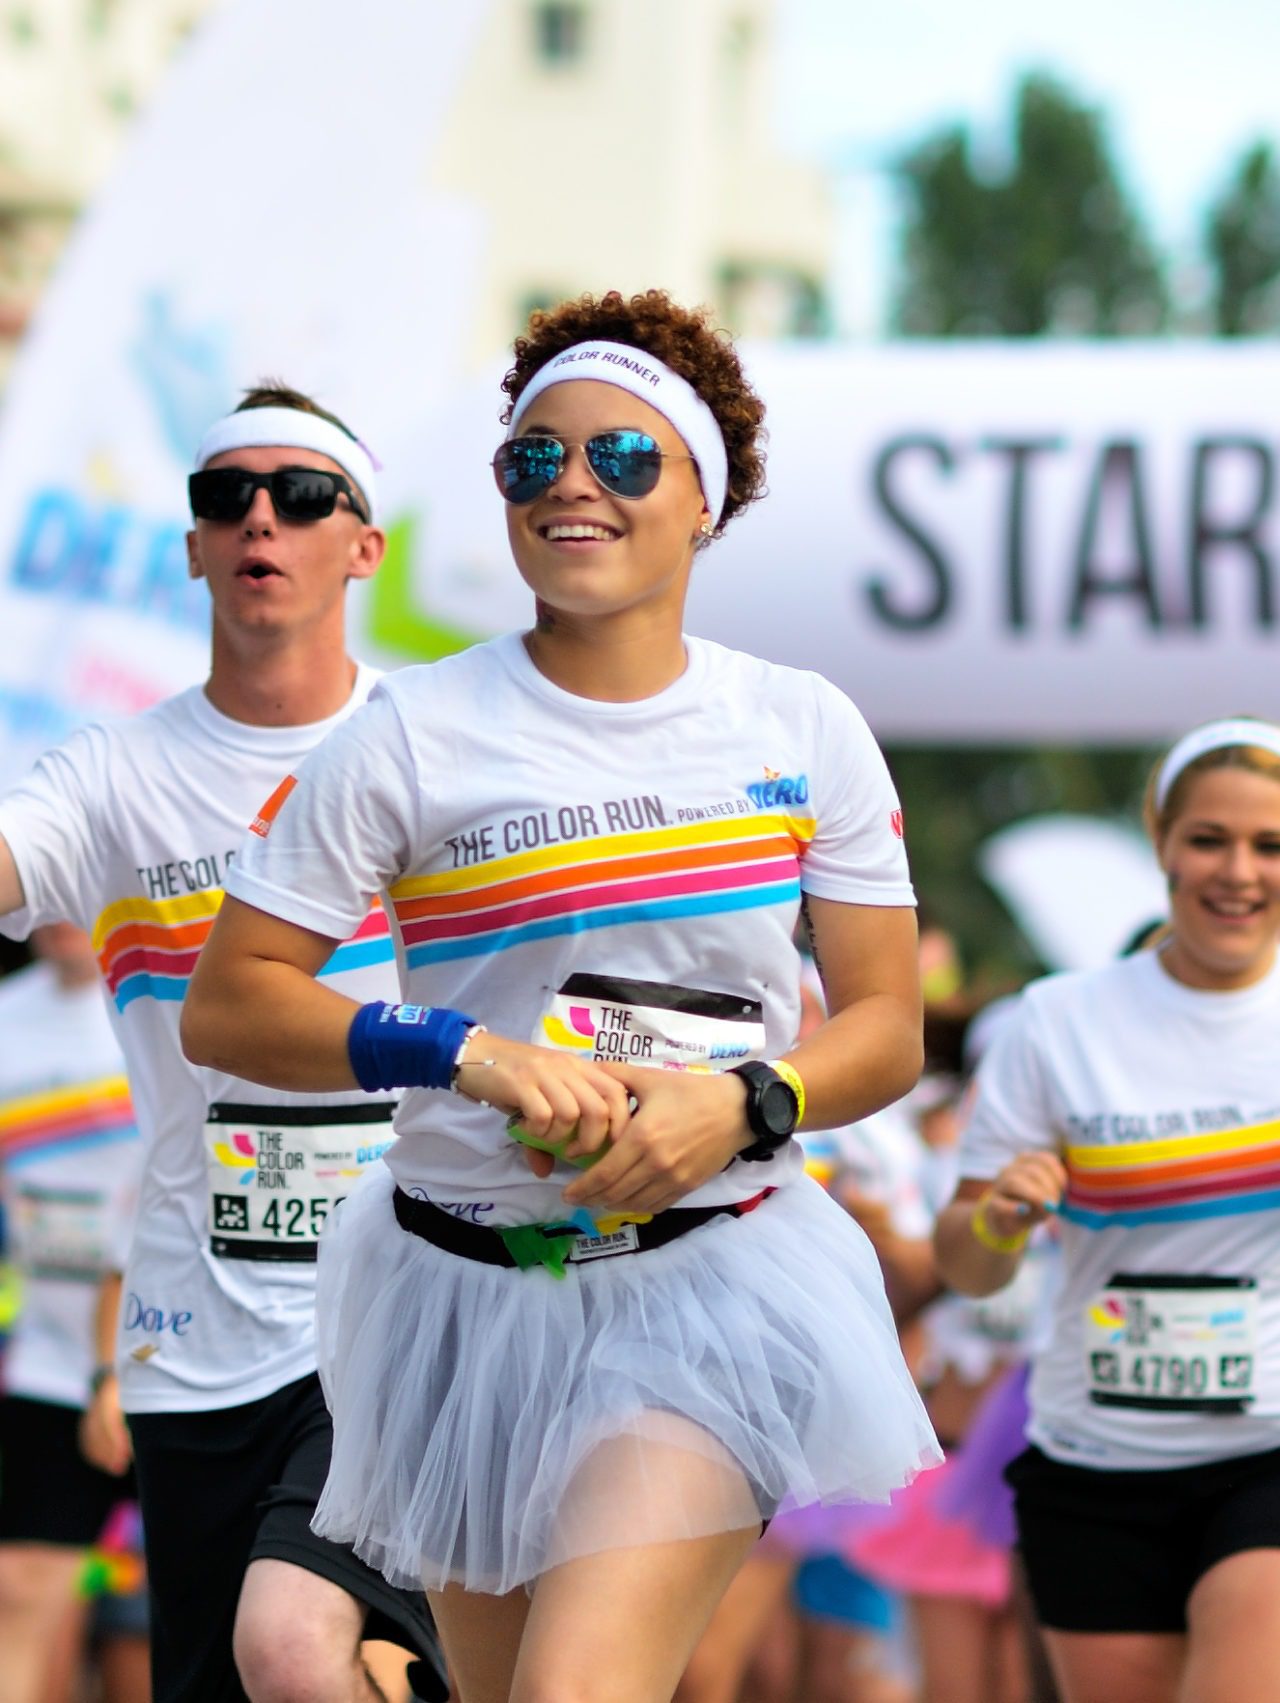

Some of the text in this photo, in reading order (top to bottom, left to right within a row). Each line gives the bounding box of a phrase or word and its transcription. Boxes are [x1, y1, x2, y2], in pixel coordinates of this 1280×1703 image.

[601, 351, 661, 387] RUNNER
[444, 826, 496, 868] THE
[502, 805, 600, 854] COLOR
[677, 801, 735, 822] POWERED
[736, 799, 750, 813] BY
[745, 774, 809, 809] DERO
[136, 862, 180, 900] THE
[601, 1006, 633, 1031] THE
[595, 1031, 653, 1057] COLOR
[257, 1131, 283, 1151] THE
[257, 1151, 304, 1170] COLOR
[262, 1195, 347, 1237] 425
[125, 1292, 192, 1336] Dove
[1131, 1355, 1208, 1394] 4790
